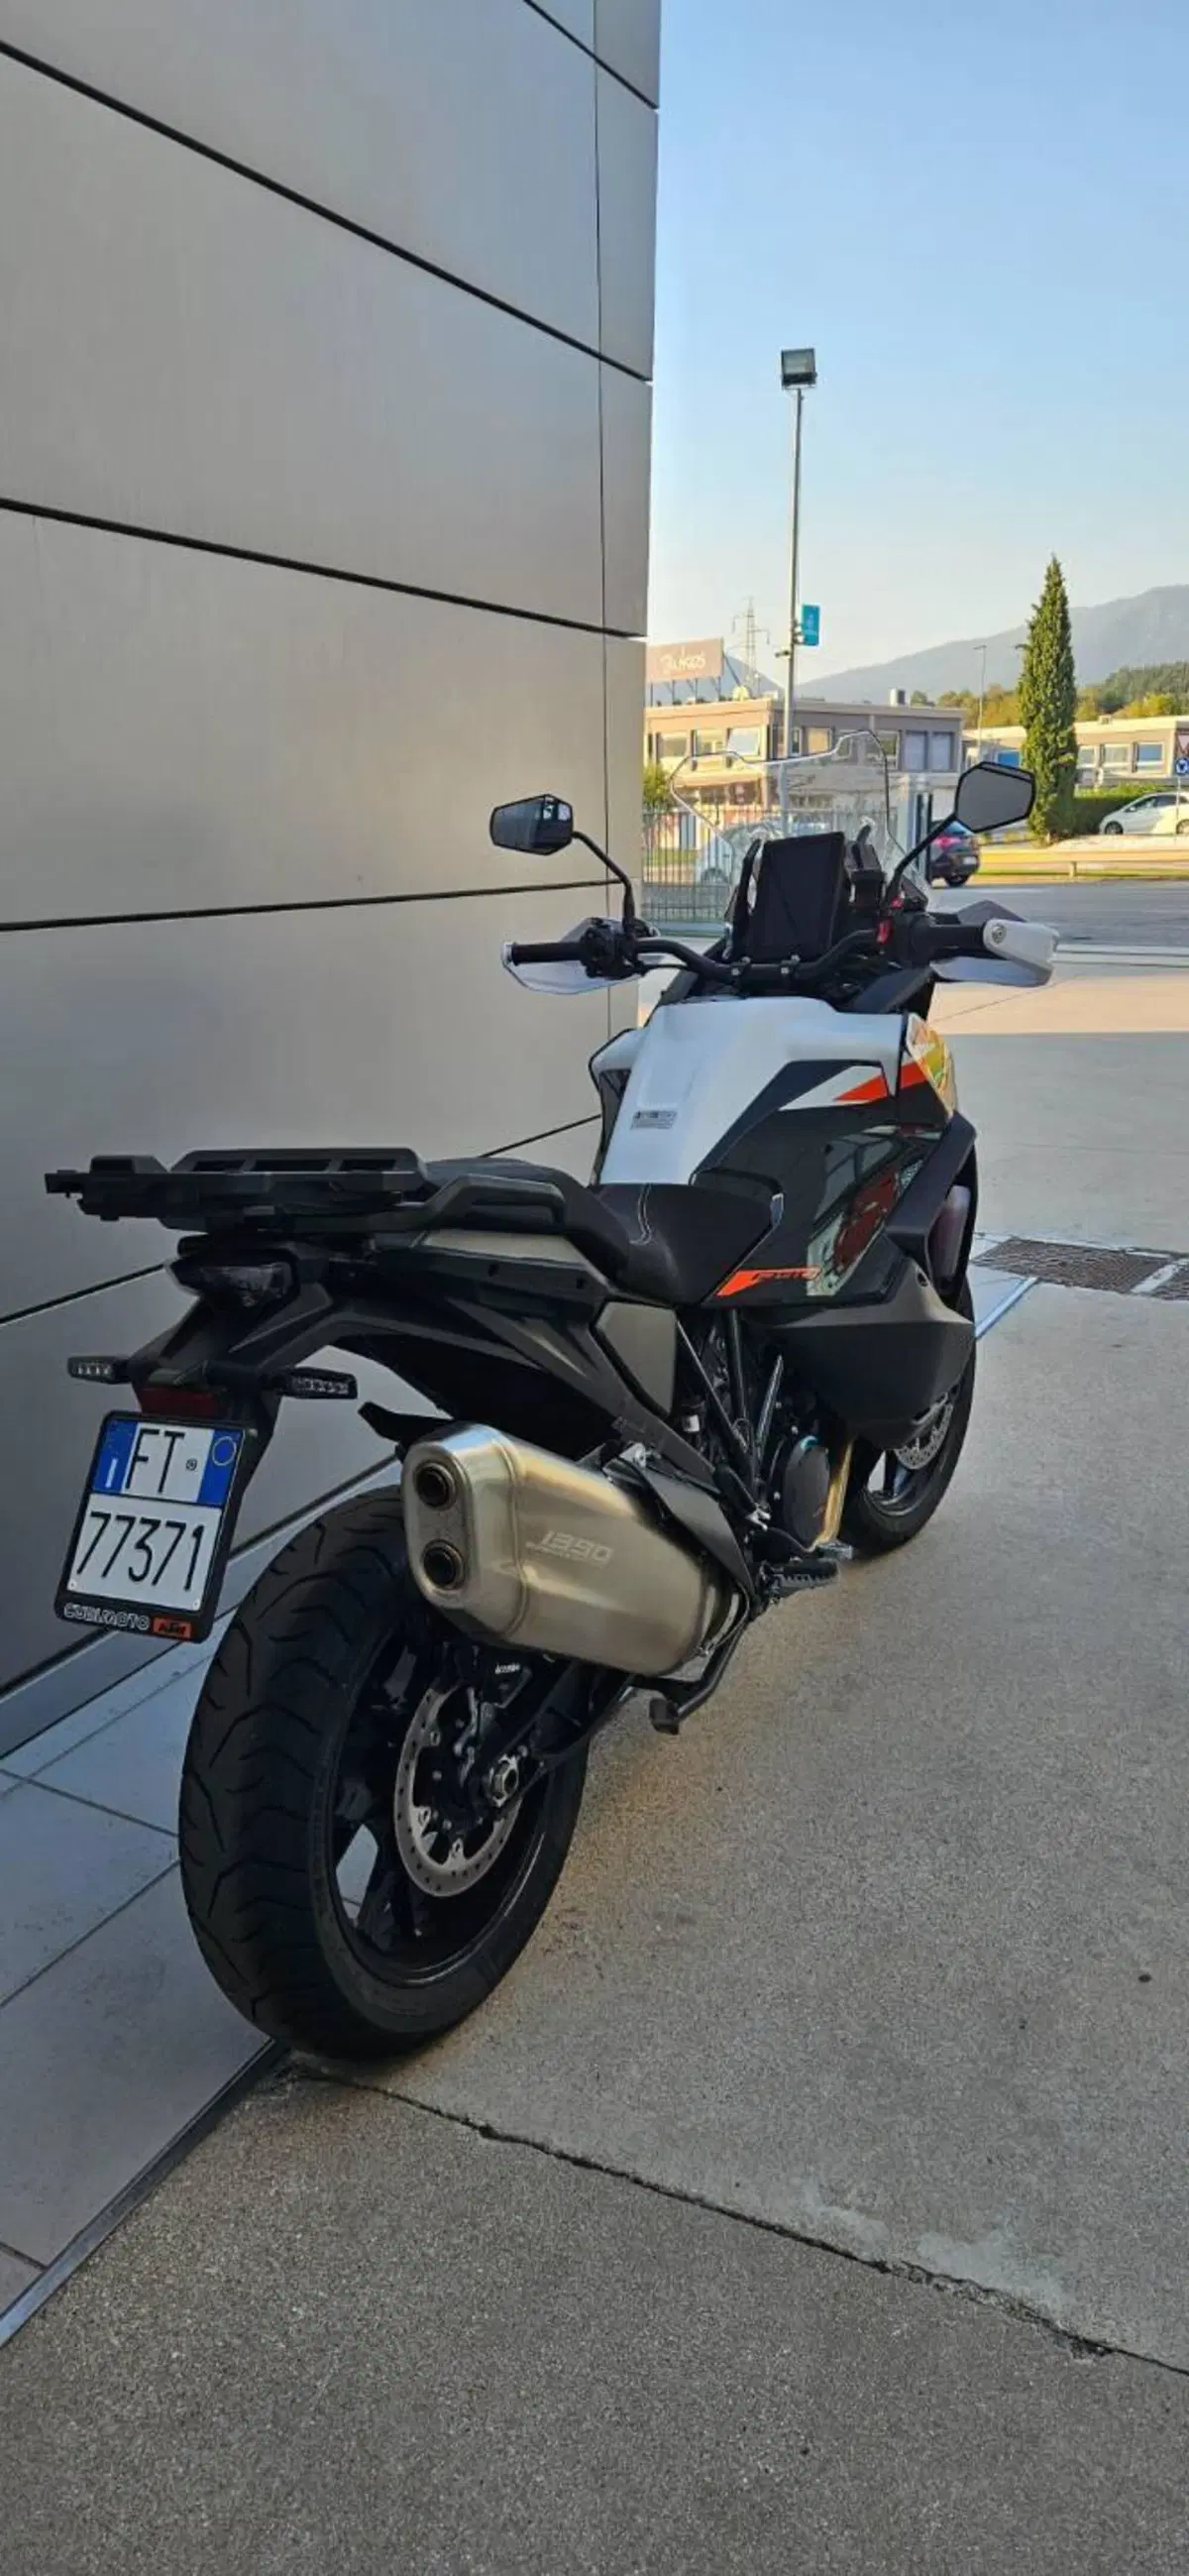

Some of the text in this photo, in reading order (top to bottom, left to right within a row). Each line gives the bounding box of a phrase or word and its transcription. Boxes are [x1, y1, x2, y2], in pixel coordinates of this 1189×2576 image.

[125, 1428, 185, 1493] FT
[77, 1512, 204, 1591] 77371
[540, 1529, 614, 1568] 1390
